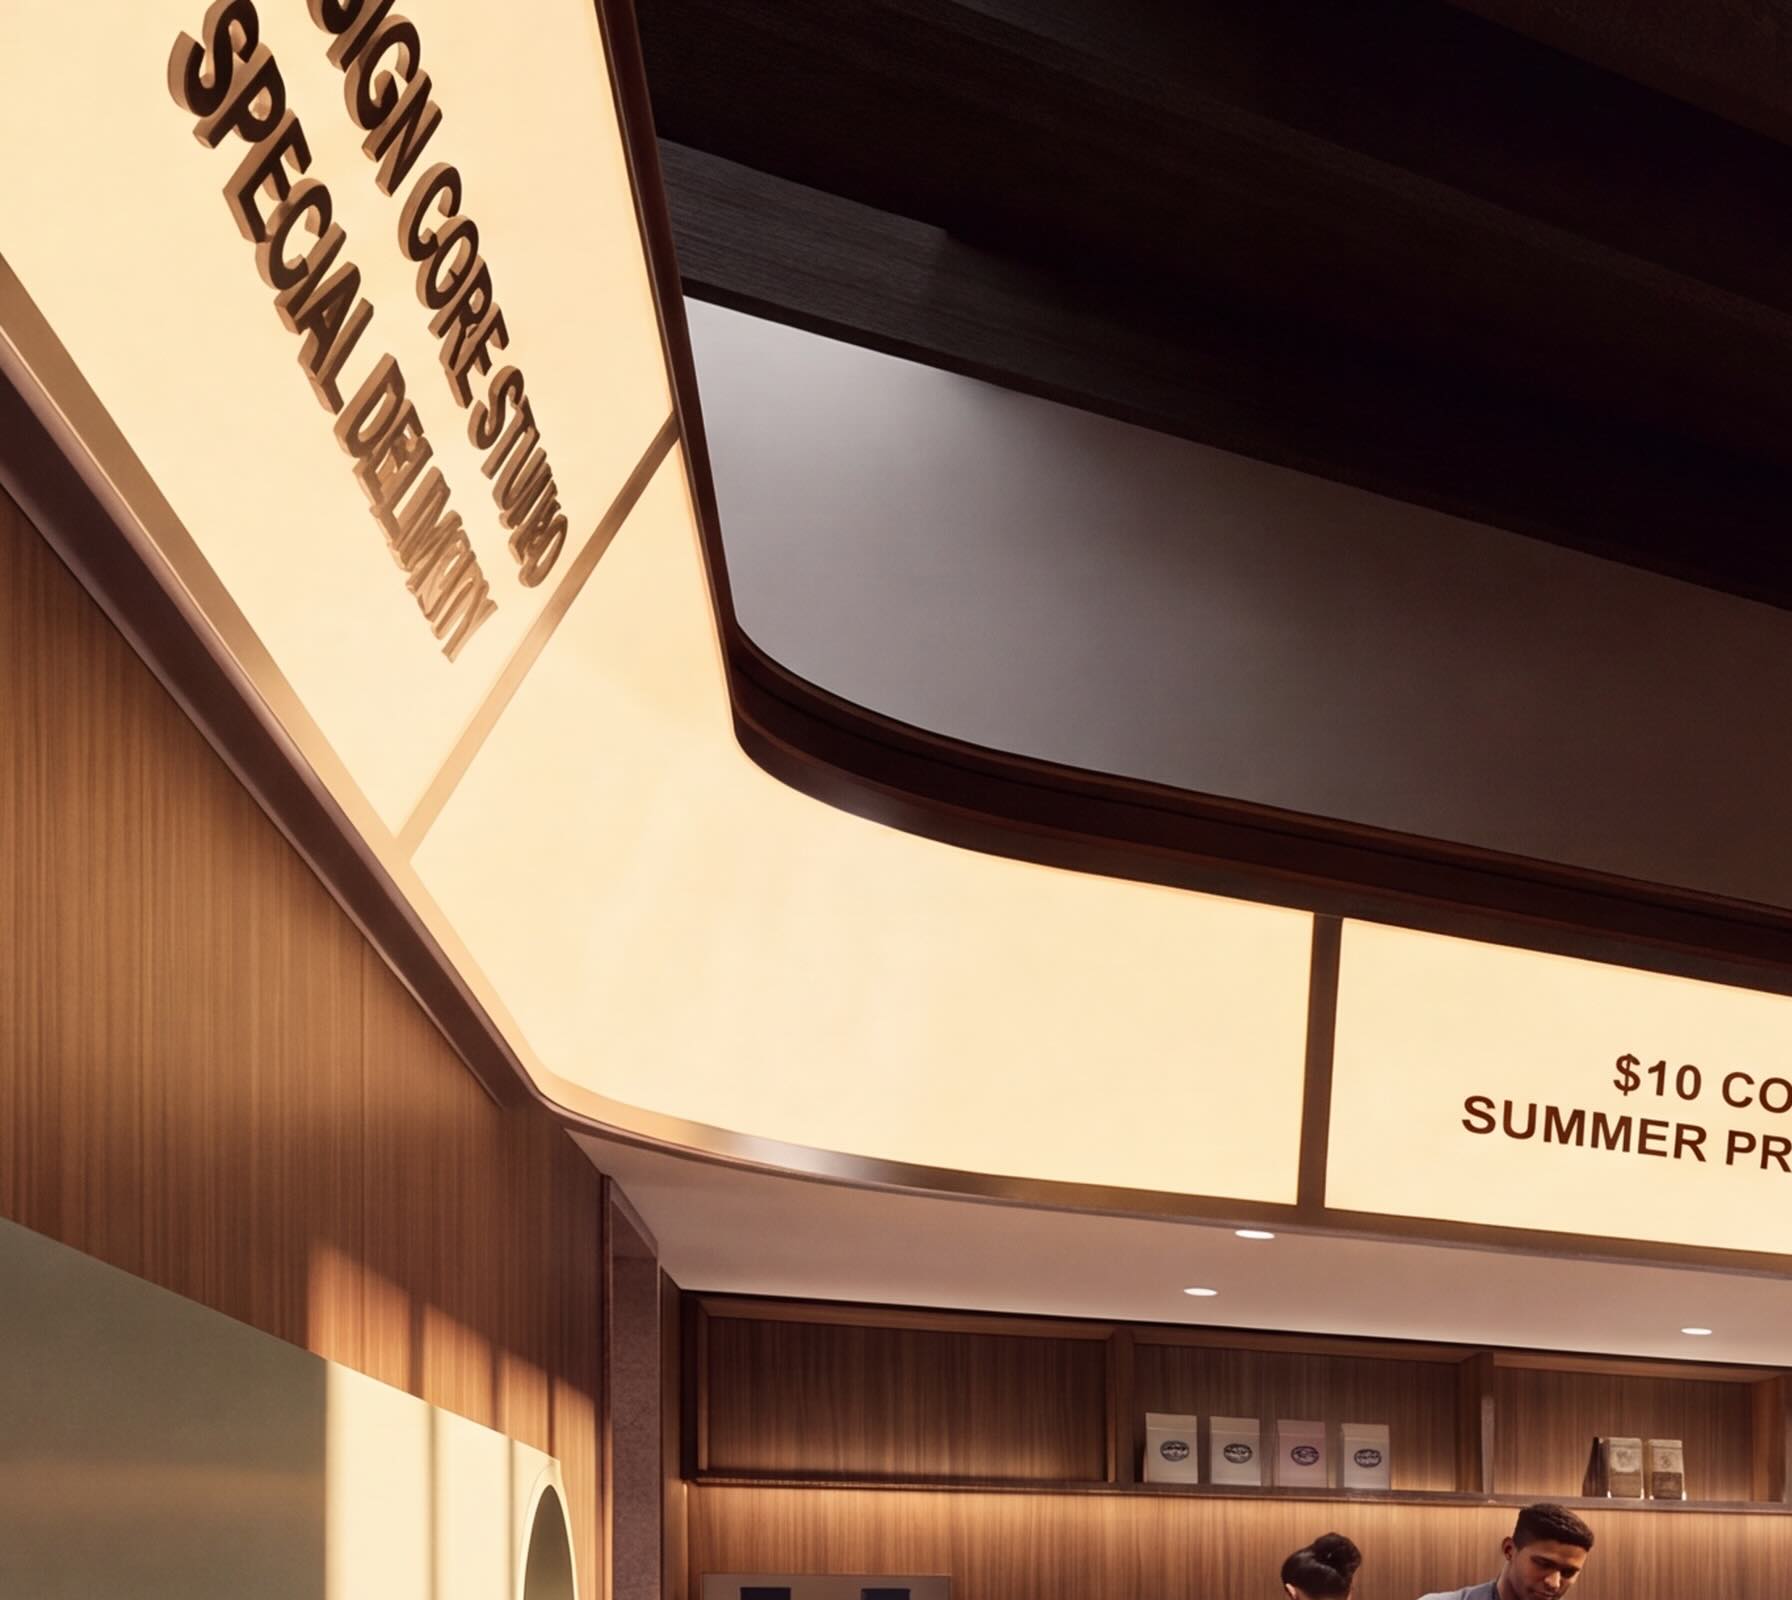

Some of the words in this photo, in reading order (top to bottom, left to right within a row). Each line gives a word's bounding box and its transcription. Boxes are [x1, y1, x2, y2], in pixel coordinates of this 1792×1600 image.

[167, 0, 374, 415] SPECIAL
[398, 162, 510, 409] CORE
[1461, 1095, 1707, 1163] SUMMER
[1613, 1053, 1702, 1101] $10
